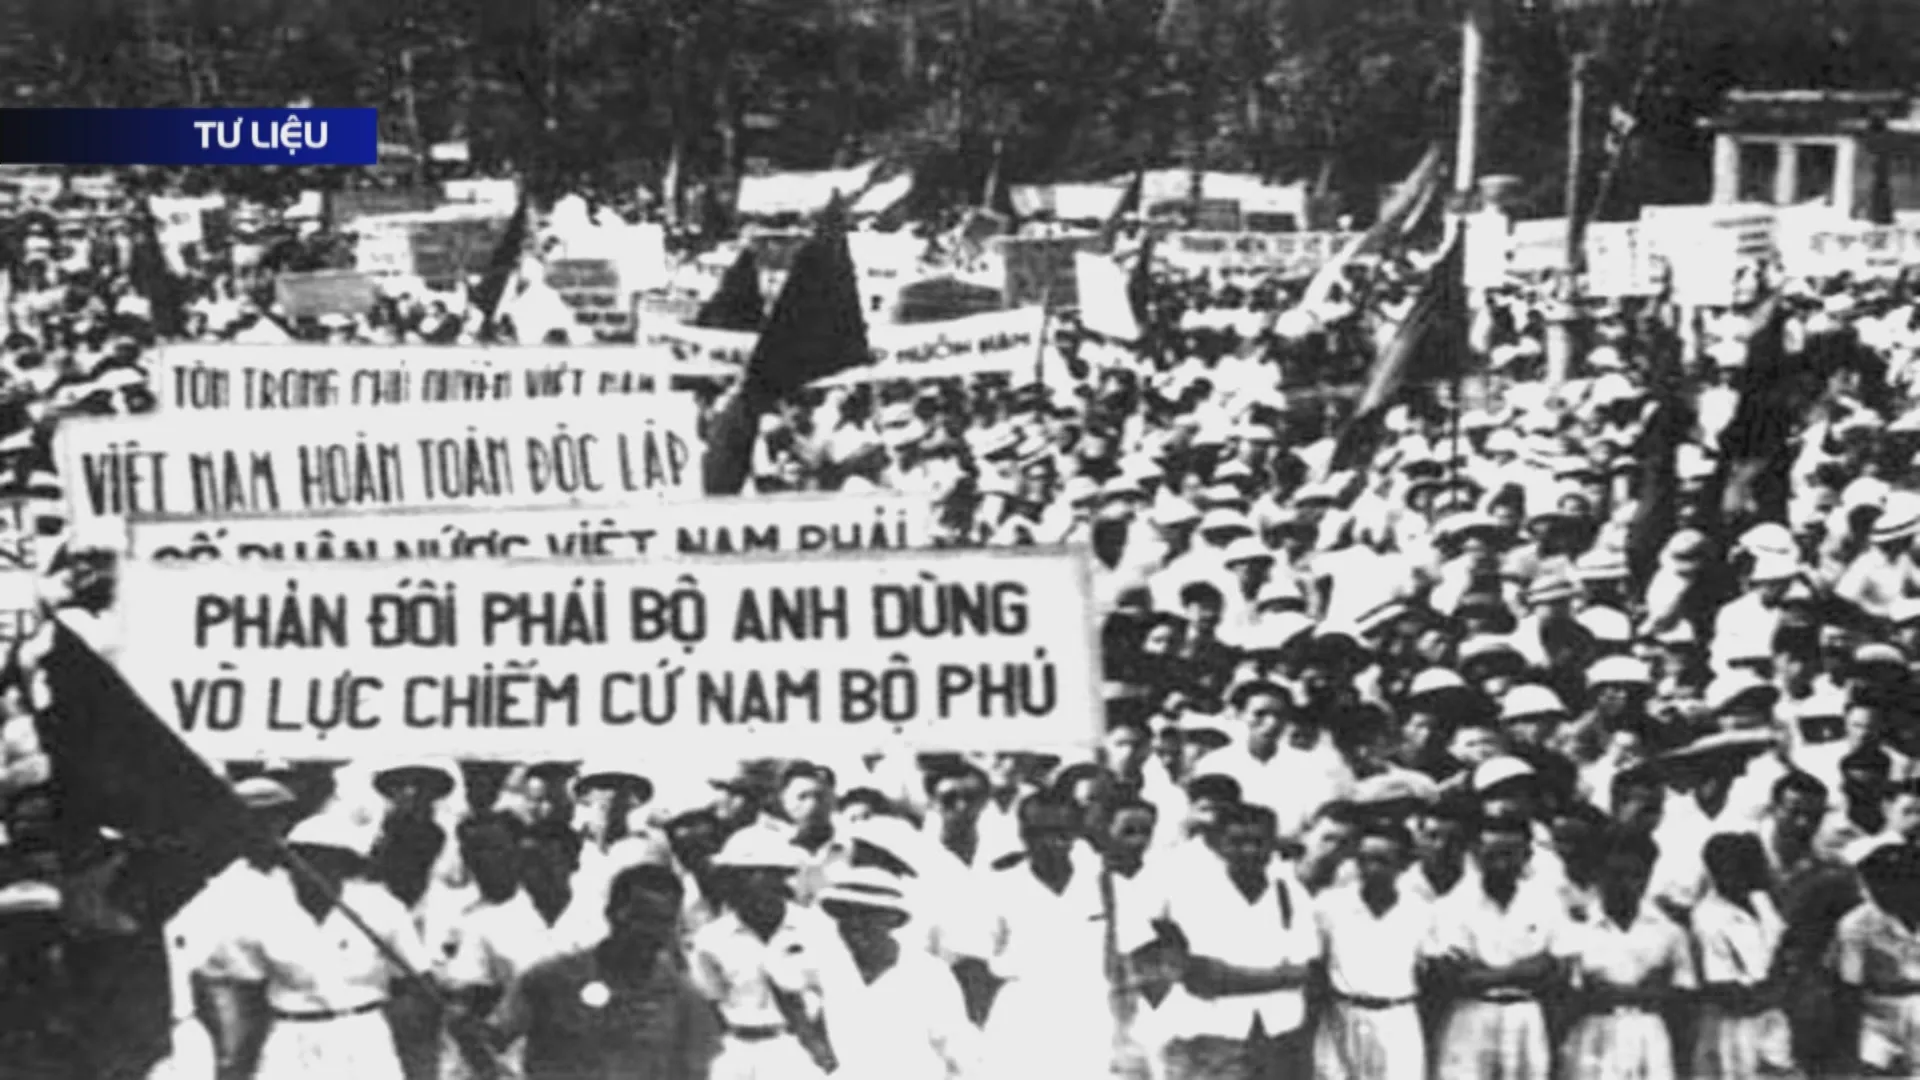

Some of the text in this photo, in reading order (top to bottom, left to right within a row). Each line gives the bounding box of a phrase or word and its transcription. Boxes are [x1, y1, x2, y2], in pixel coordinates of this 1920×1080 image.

[188, 449, 280, 513] NAM
[194, 571, 1030, 654] PHẢN ĐỐI PHÁI BỘ ANH DÙNG
[267, 669, 384, 741] LỰC
[600, 657, 686, 726] CỨ
[839, 653, 918, 735] BỘ
[937, 646, 1058, 719] PHỦ
